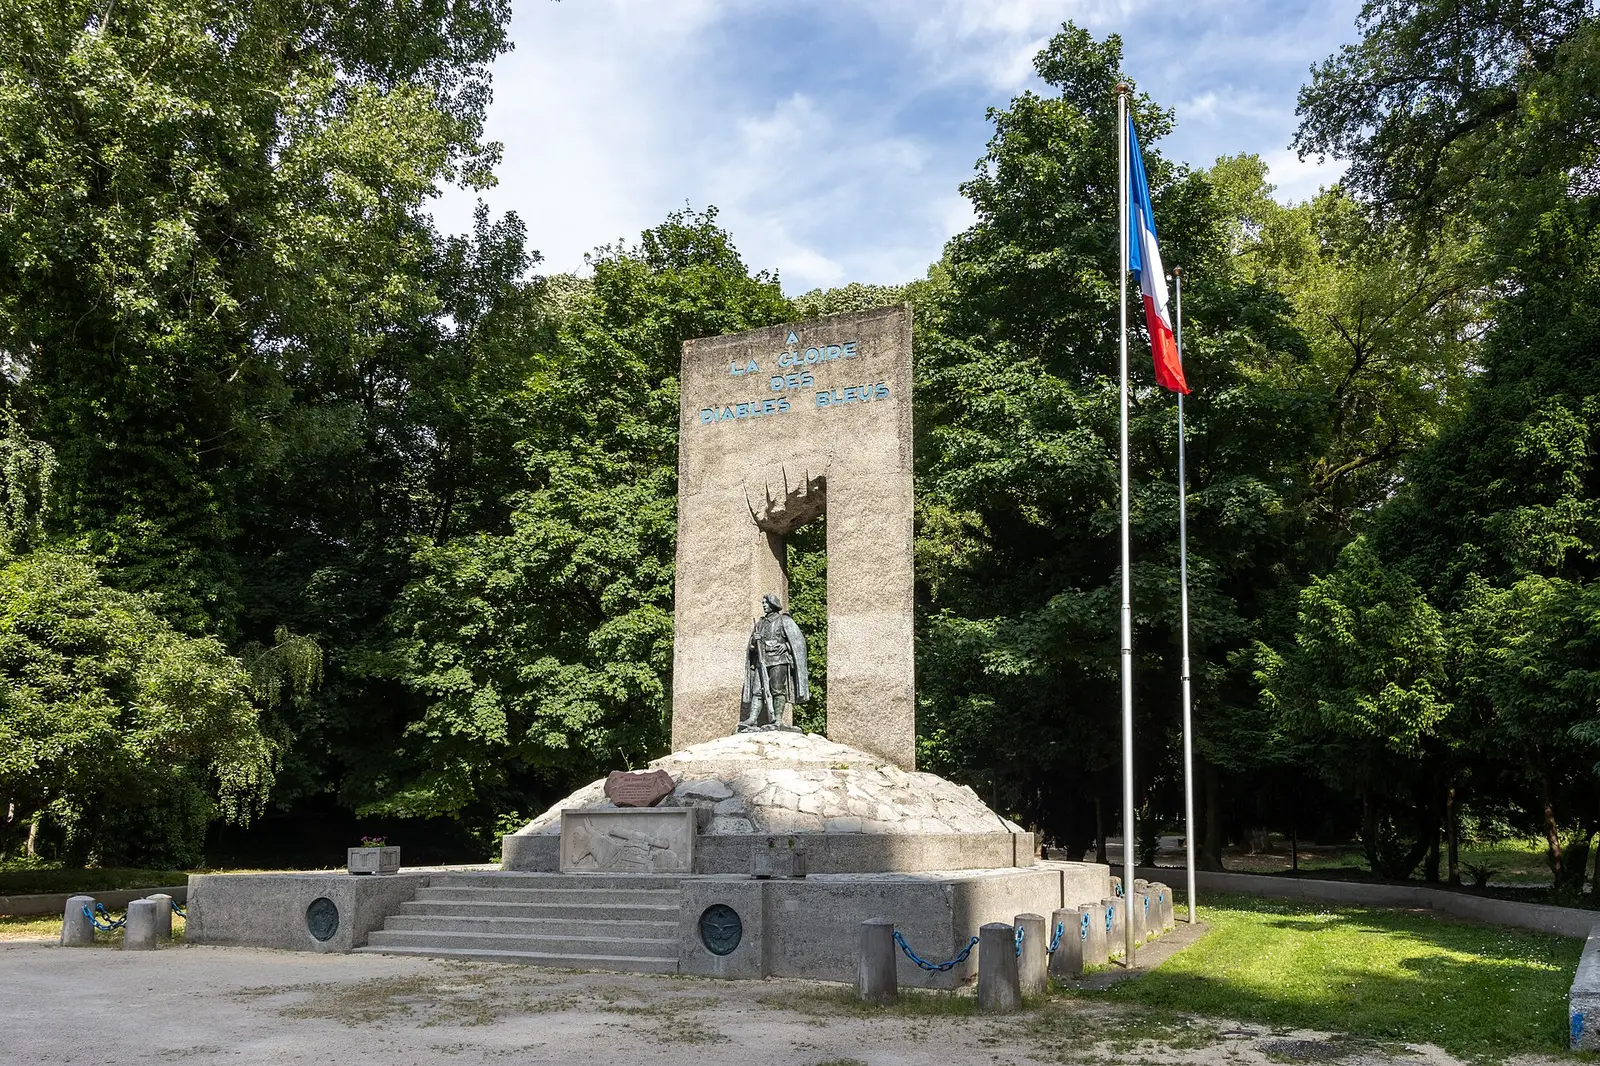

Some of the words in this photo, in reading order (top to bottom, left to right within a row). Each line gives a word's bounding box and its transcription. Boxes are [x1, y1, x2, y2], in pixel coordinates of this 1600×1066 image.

[786, 330, 800, 345] A
[730, 359, 760, 376] LA
[778, 341, 857, 368] GLOIRE
[770, 371, 814, 391] DES
[701, 397, 791, 425] DIABLES
[815, 382, 890, 407] BLEUS
